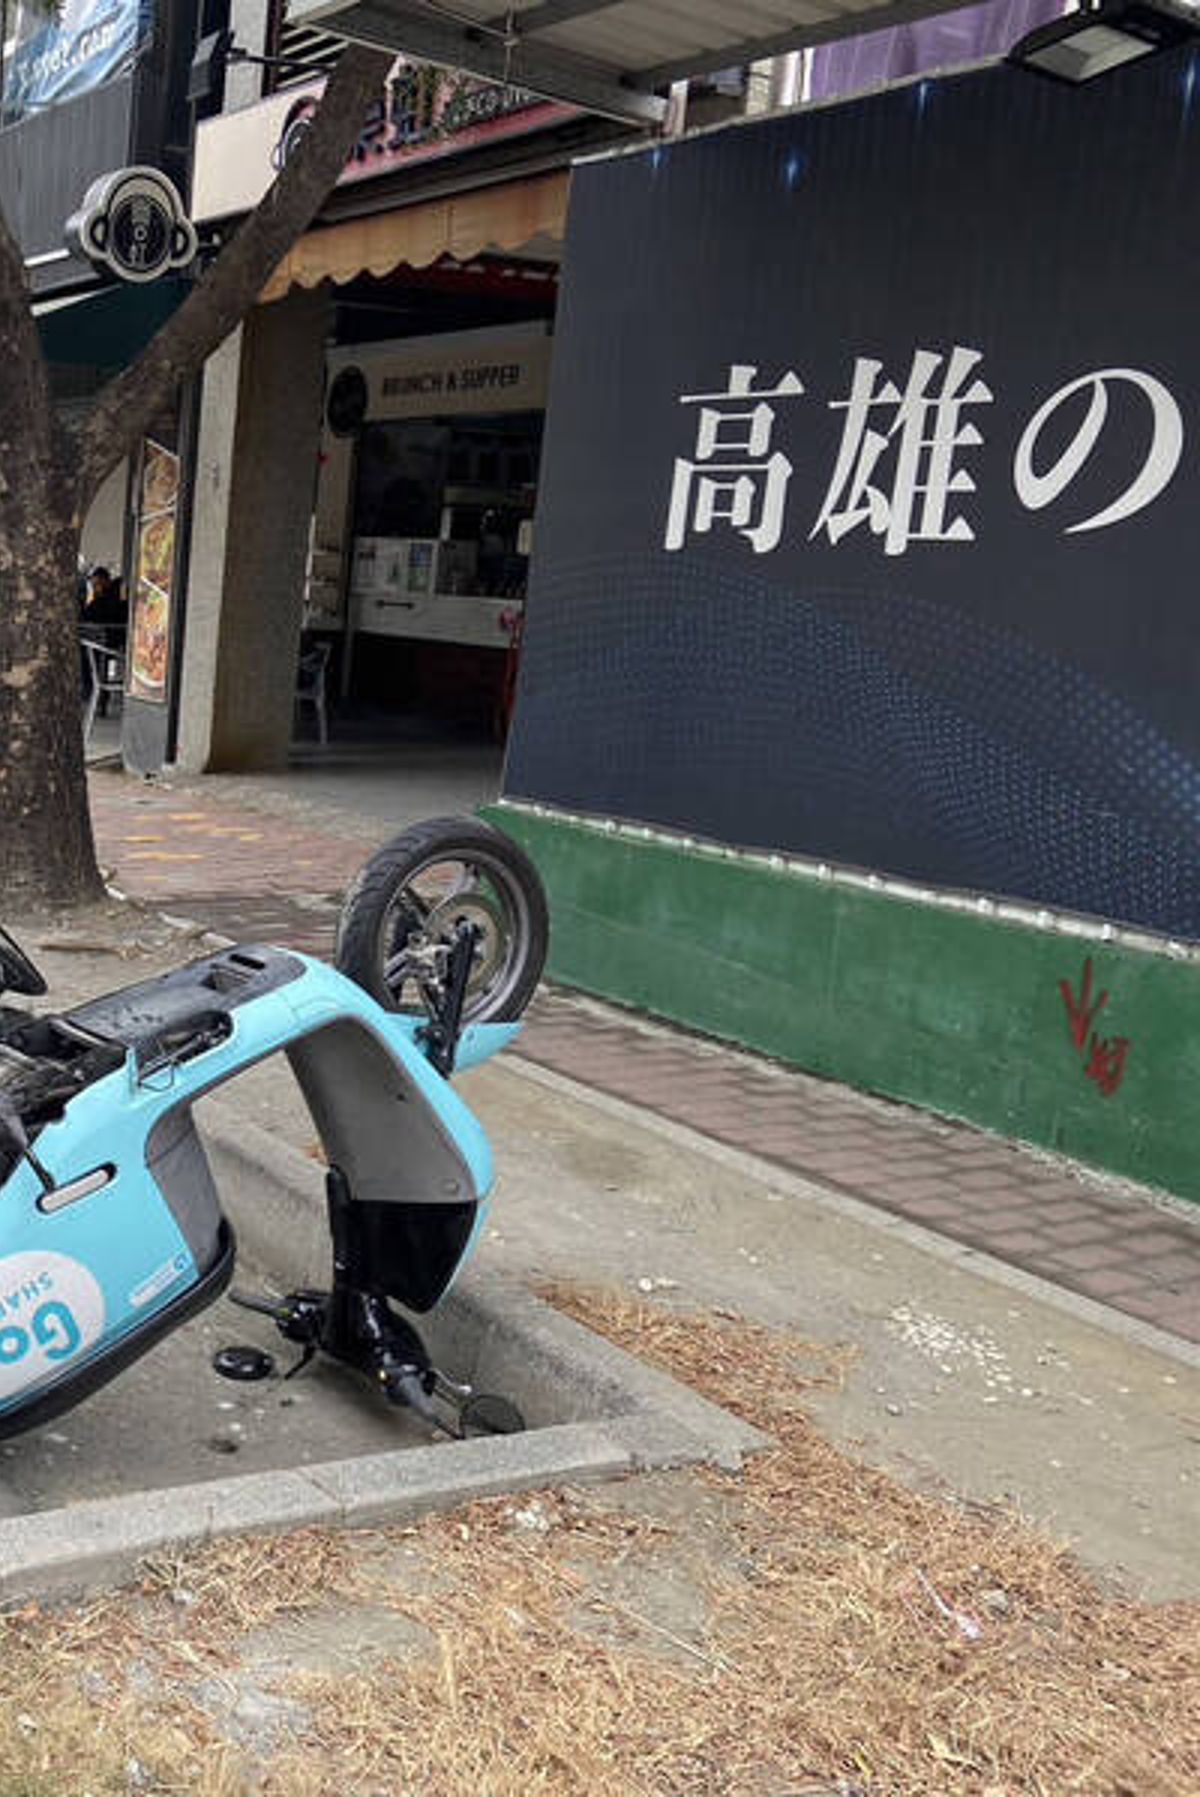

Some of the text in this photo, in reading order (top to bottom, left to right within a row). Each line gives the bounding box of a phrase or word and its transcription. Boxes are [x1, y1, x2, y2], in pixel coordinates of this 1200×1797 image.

[461, 363, 520, 389] SUPPER
[664, 345, 1184, 556] 高雄の
